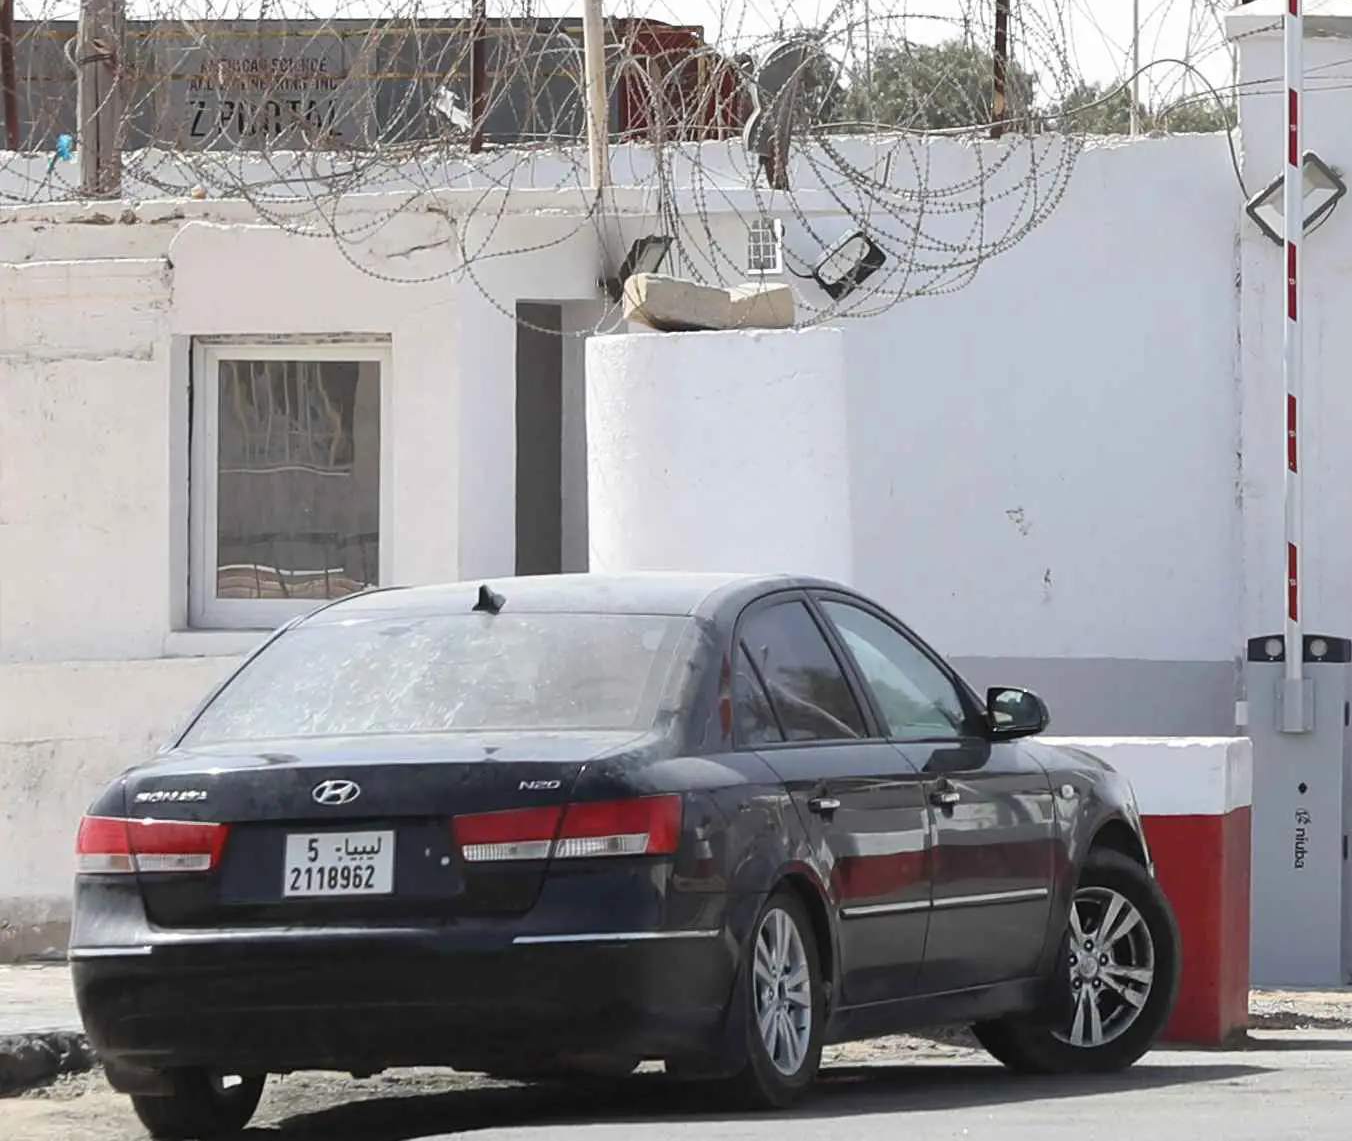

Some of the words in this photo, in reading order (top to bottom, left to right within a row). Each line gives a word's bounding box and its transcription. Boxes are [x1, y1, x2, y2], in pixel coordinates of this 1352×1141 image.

[308, 838, 319, 862] 5
[1294, 827, 1309, 869] niuba
[290, 864, 376, 891] 2118962
